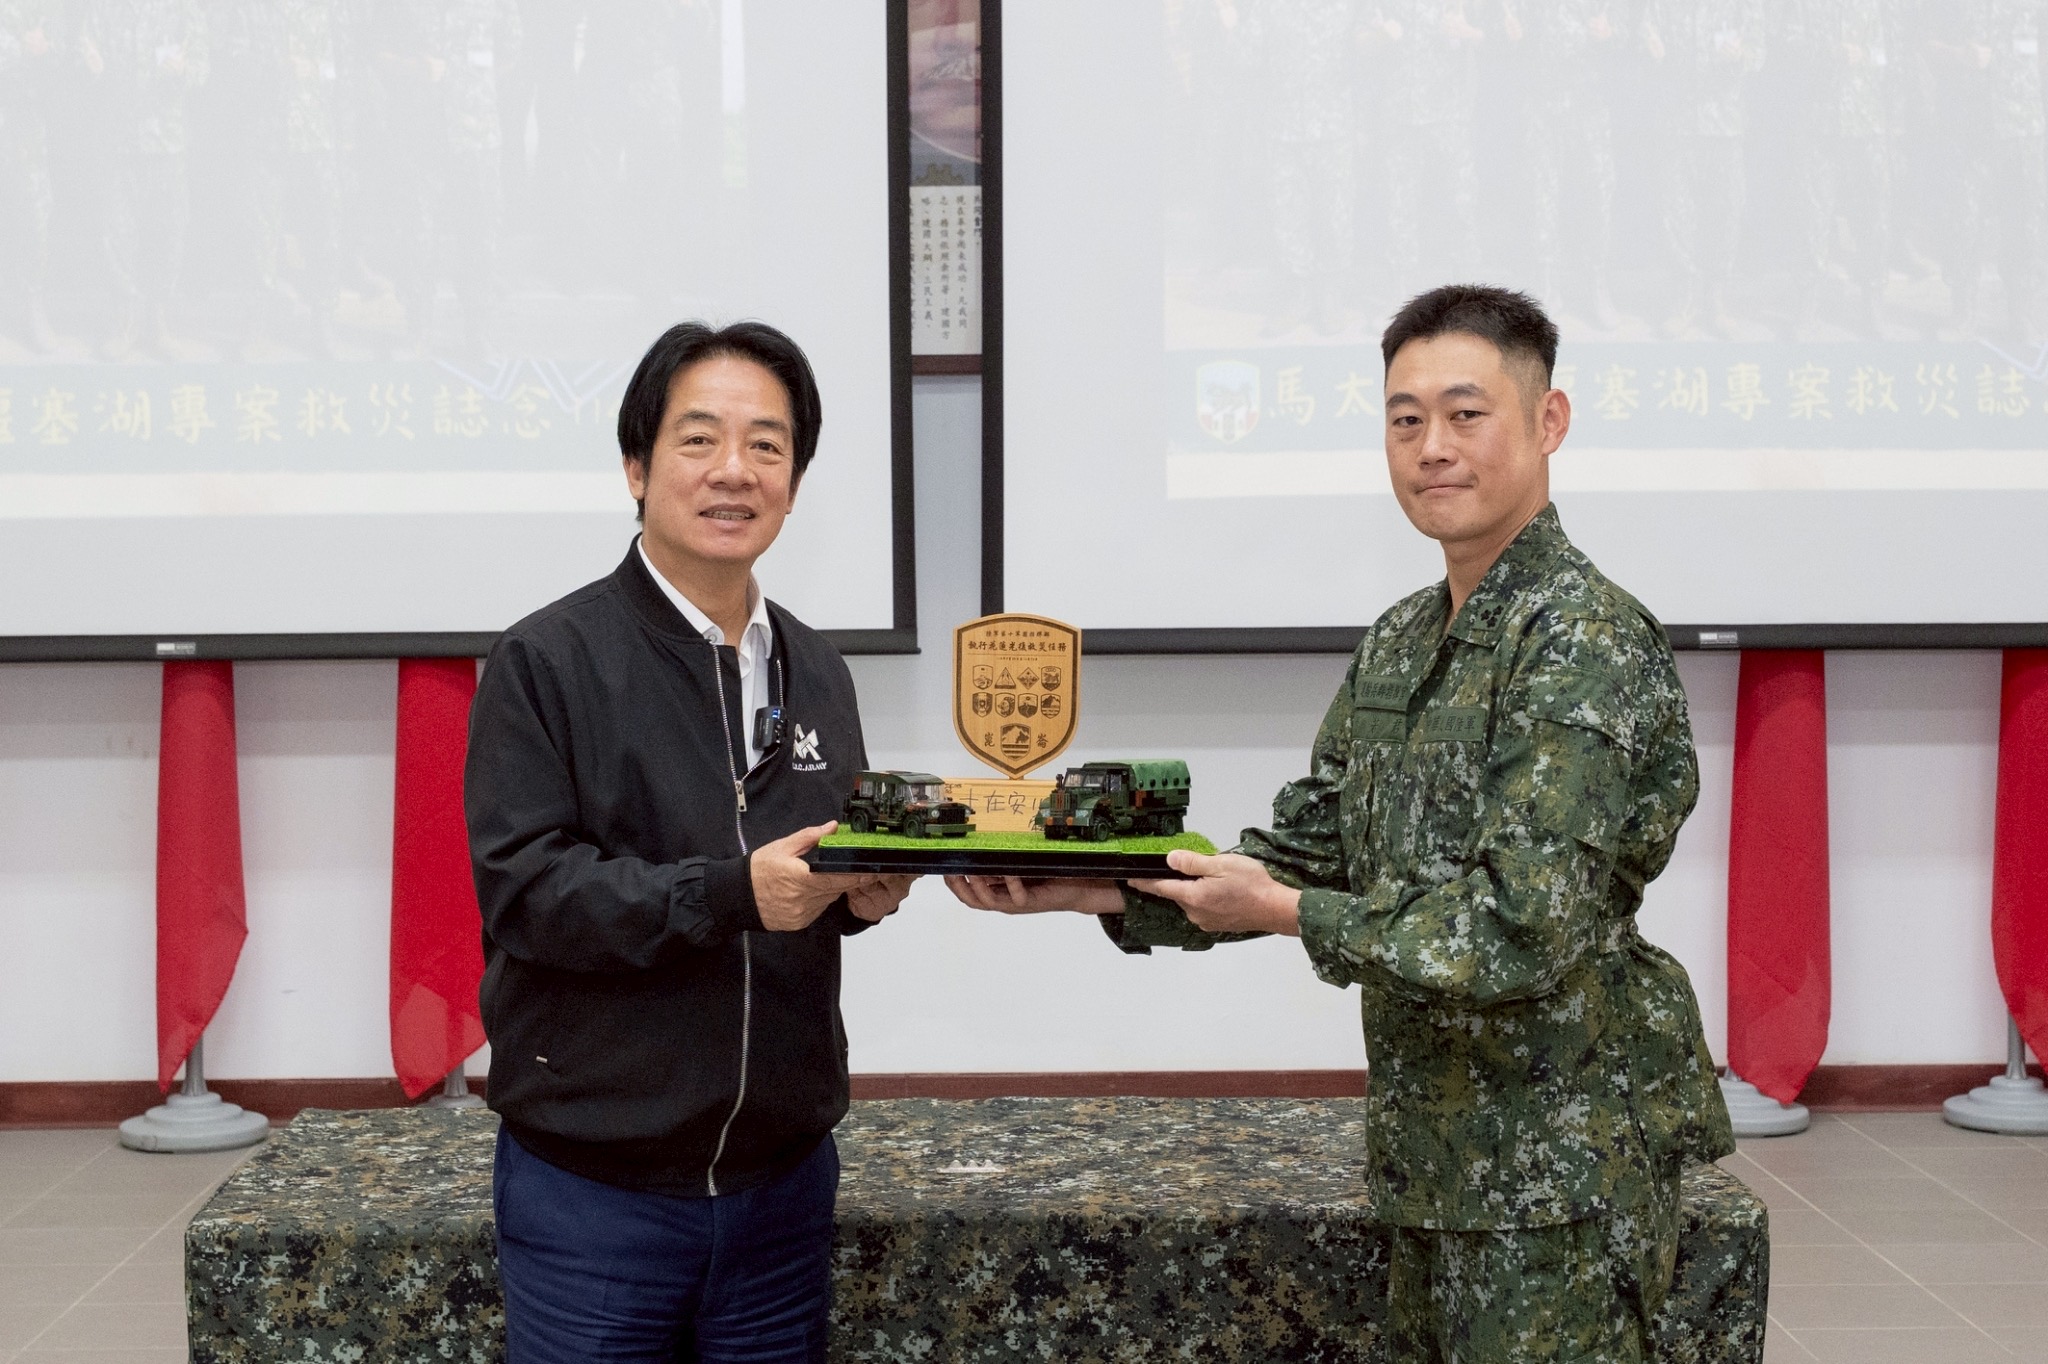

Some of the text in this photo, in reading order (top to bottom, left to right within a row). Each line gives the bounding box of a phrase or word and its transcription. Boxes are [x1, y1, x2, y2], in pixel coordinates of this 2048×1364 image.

[1553, 361, 2048, 421] 塞湖專案救災誌
